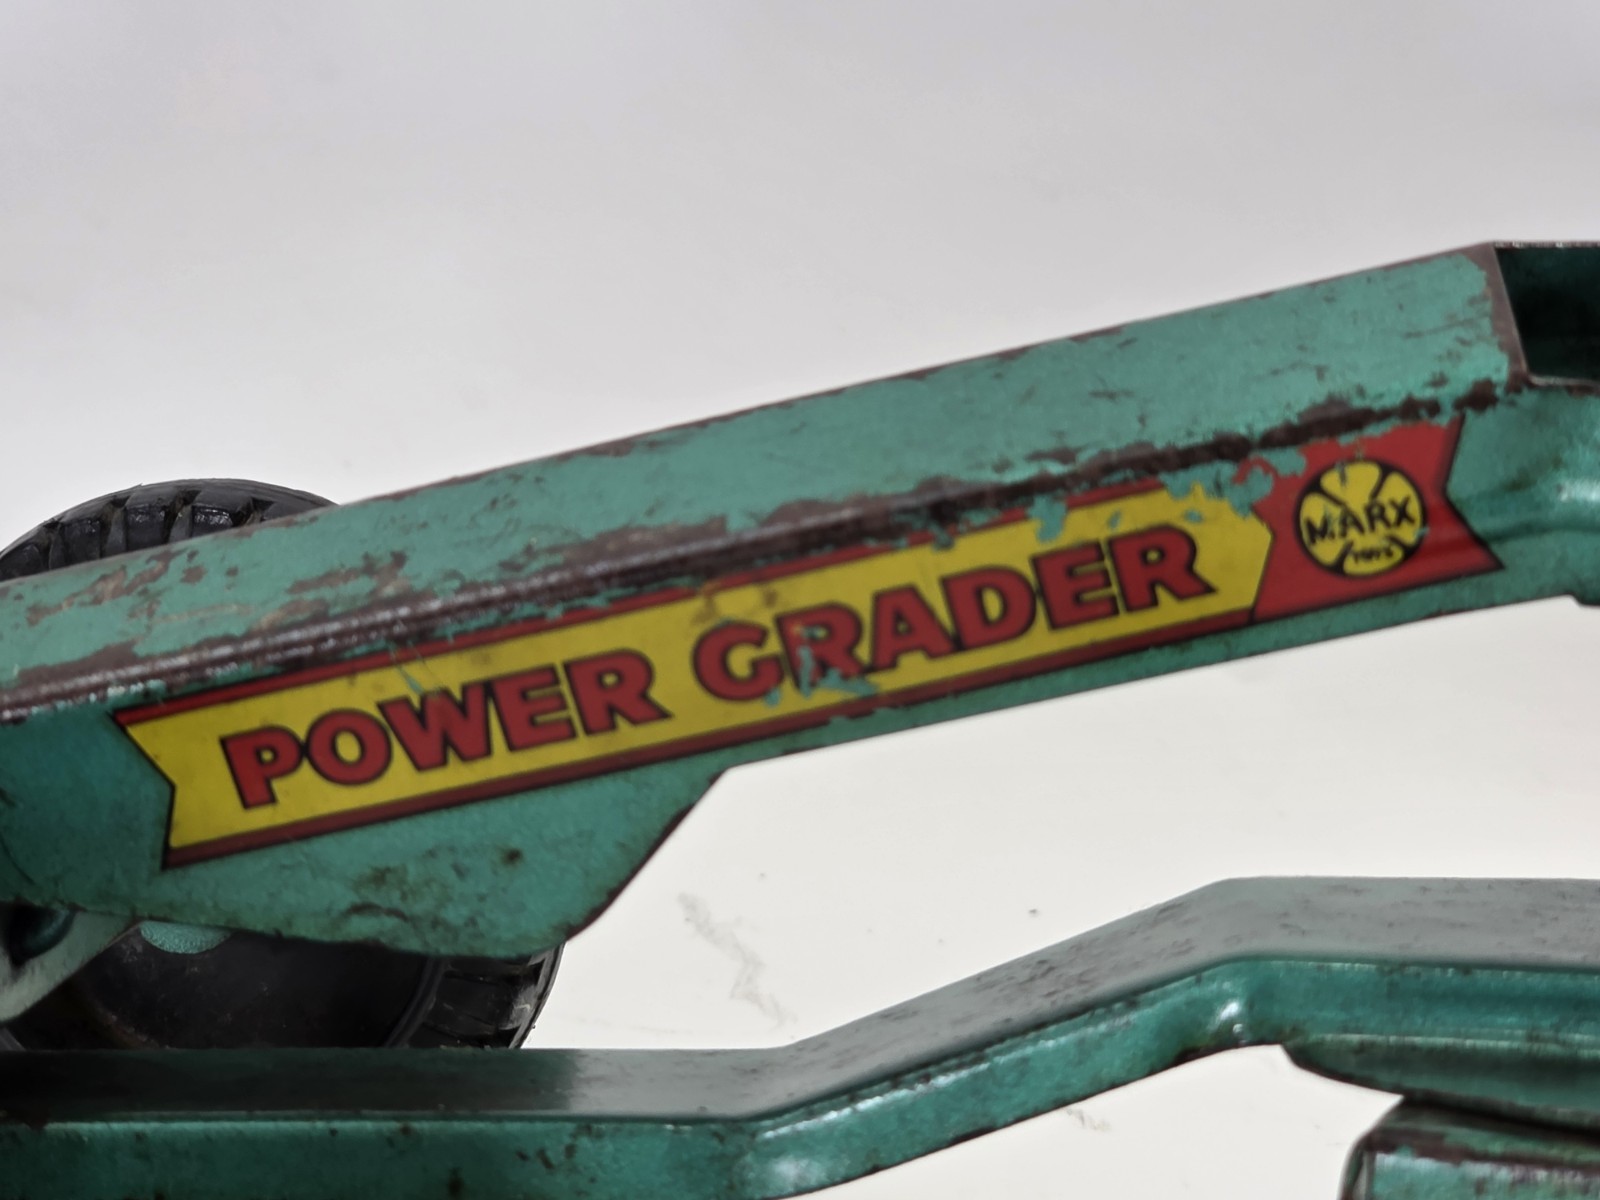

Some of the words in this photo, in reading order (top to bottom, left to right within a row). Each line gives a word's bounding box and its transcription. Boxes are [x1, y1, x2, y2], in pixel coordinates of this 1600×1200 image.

[1305, 496, 1415, 544] MARX
[219, 648, 675, 810] POWER
[691, 525, 1217, 701] GRADER
